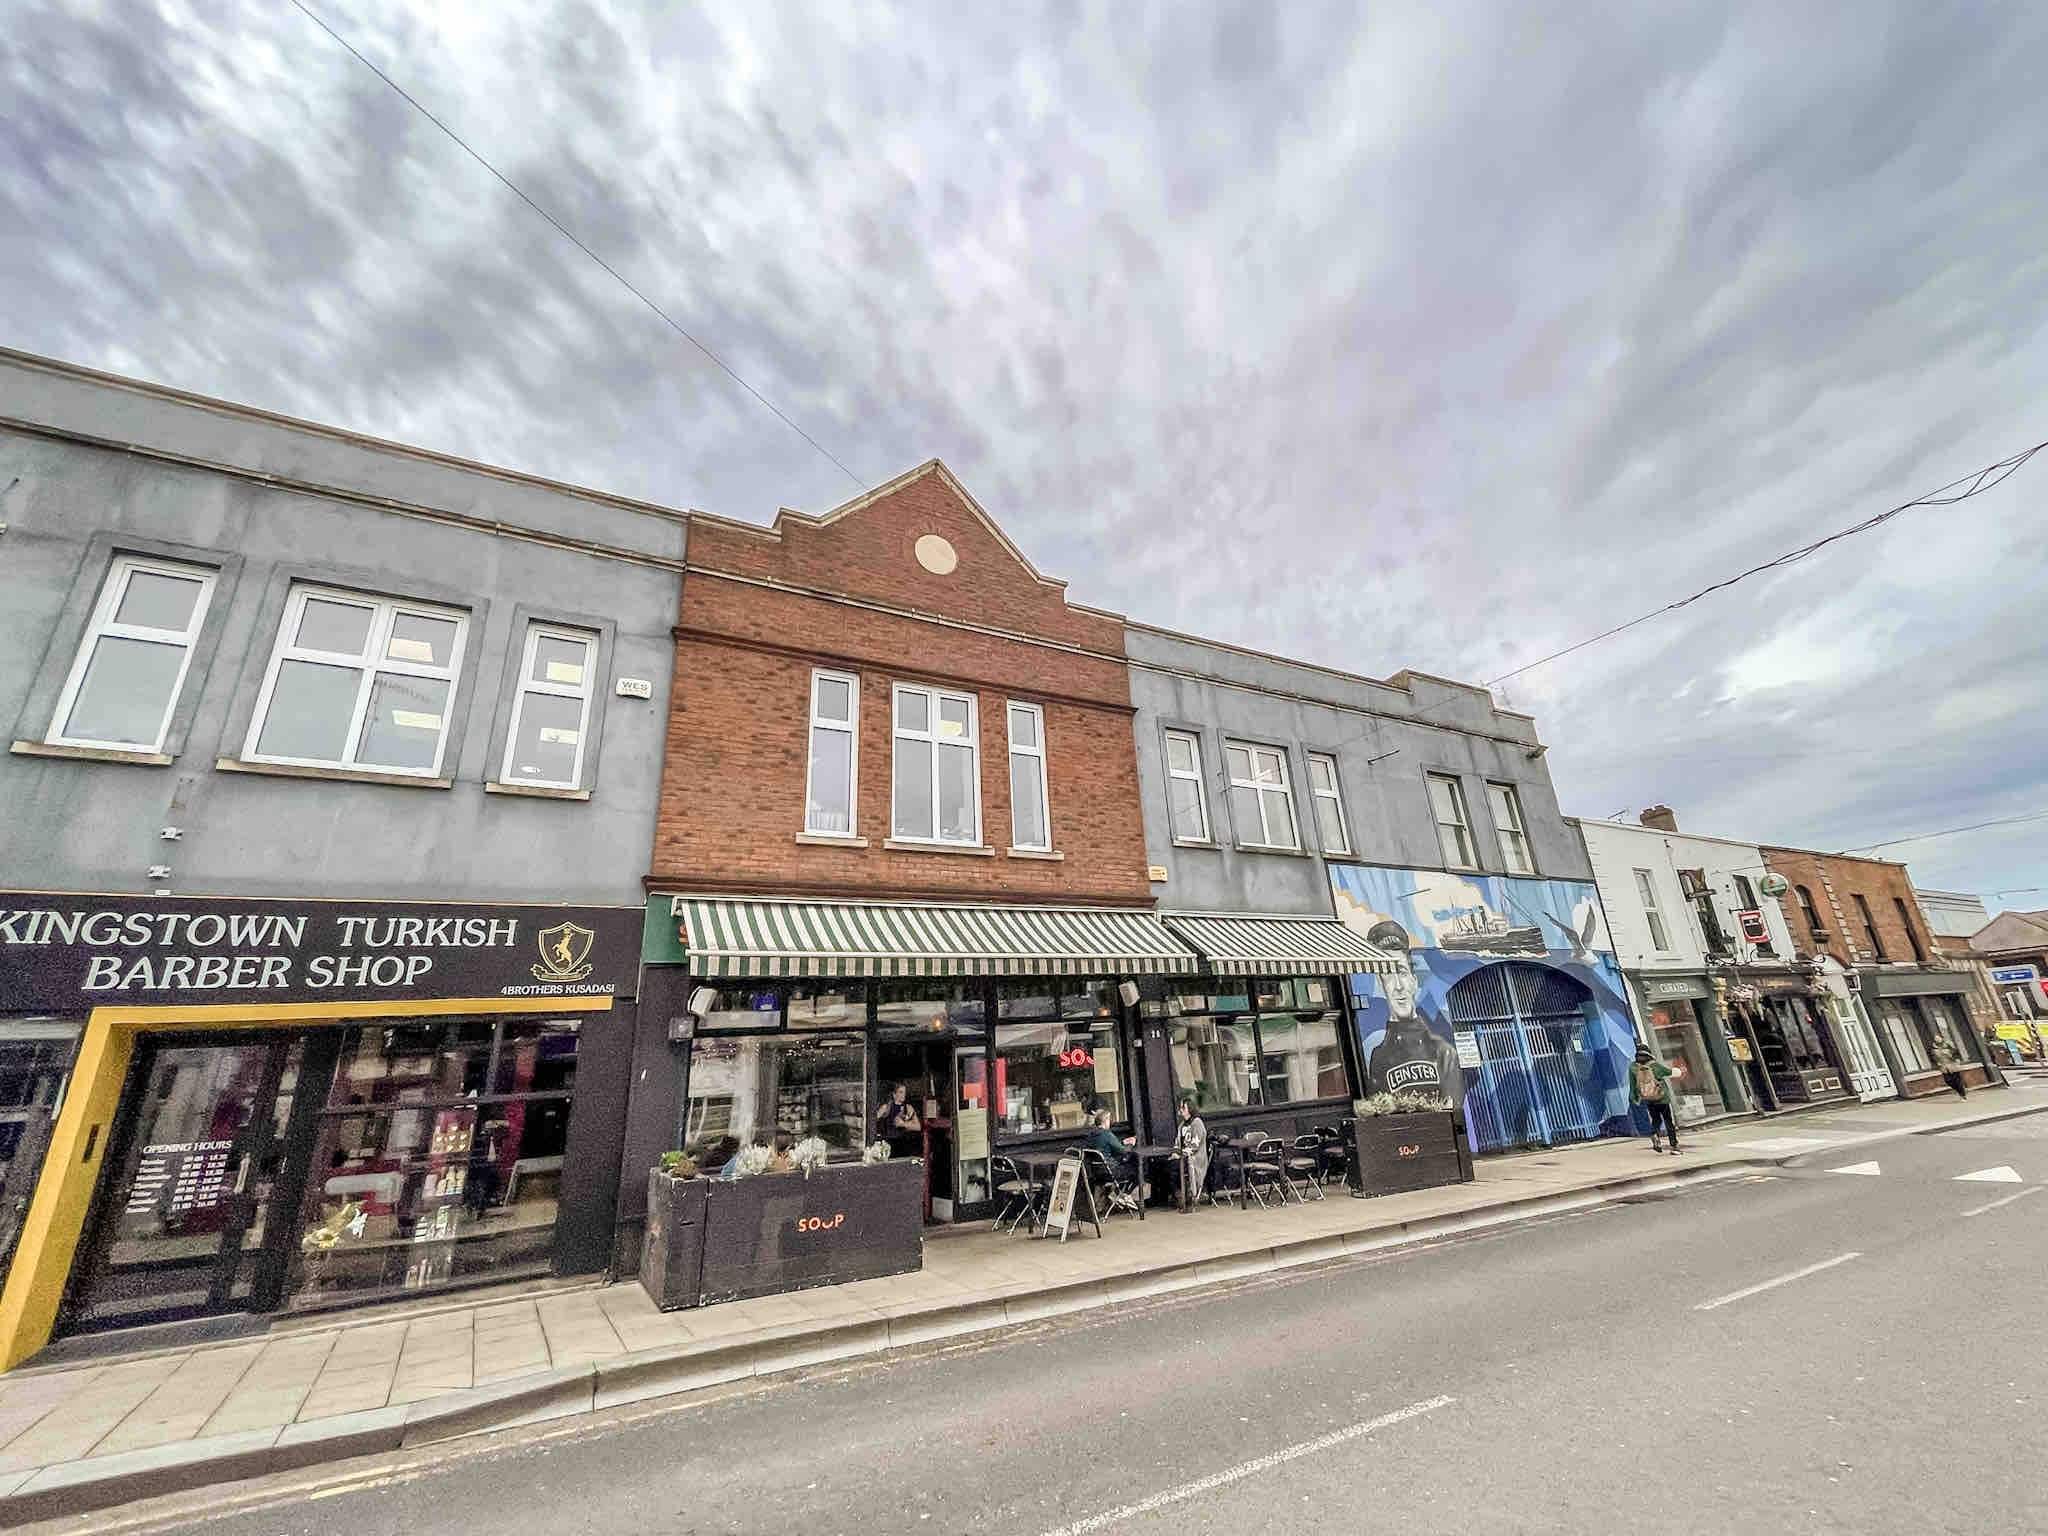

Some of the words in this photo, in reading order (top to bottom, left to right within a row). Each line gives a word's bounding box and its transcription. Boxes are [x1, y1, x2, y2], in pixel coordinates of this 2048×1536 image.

[0, 911, 308, 946] KINGSTOWN
[337, 917, 519, 947] TURKISH
[81, 956, 292, 990] BARBER
[305, 956, 433, 987] SHOP
[501, 984, 564, 995] 4BROTHERS
[565, 983, 615, 993] KUSADASI
[1390, 1064, 1437, 1088] LEINSTER
[143, 1143, 193, 1154] OPENING
[193, 1140, 233, 1152] HOURS
[1398, 1144, 1420, 1156] SOUP
[798, 1213, 845, 1232] SOUP
